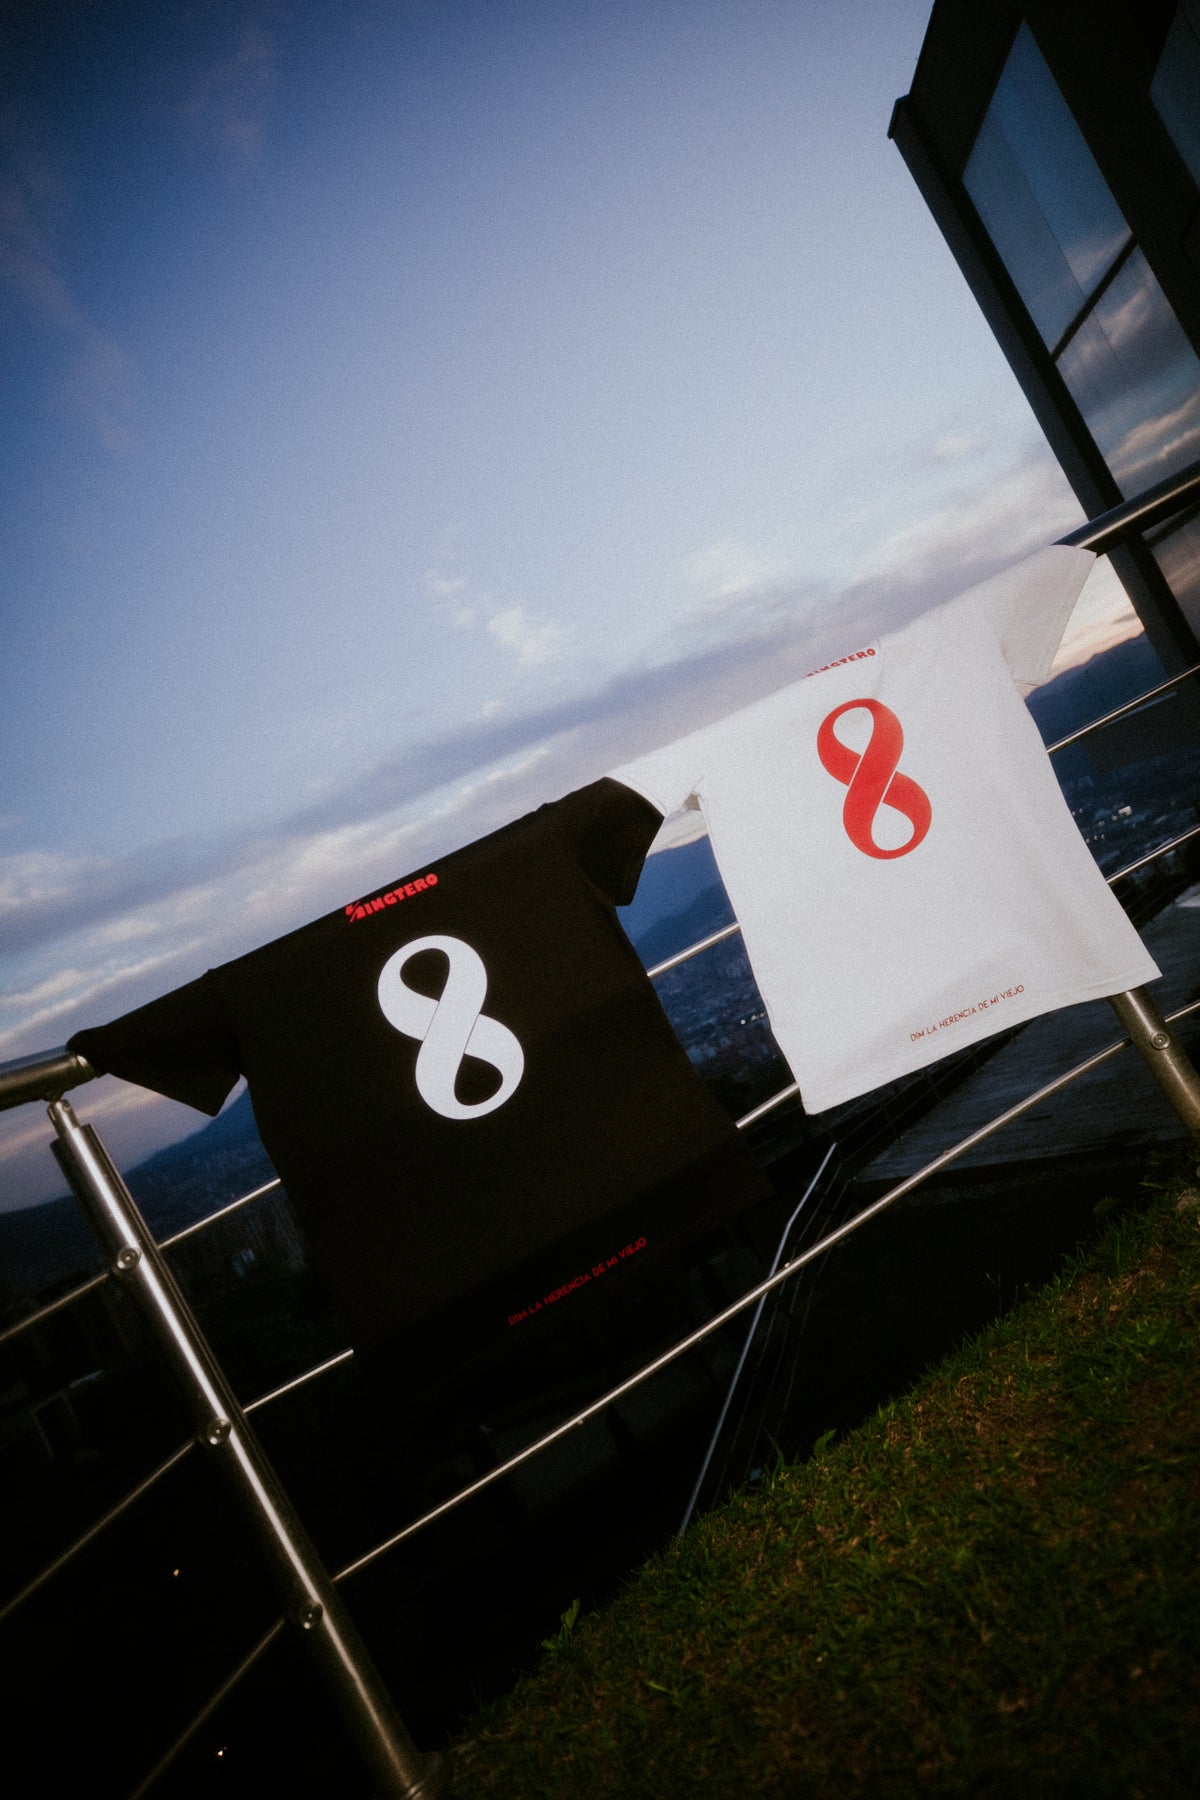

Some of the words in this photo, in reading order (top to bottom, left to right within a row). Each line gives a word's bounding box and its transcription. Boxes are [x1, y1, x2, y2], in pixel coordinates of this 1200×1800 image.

[817, 698, 932, 860] 8
[378, 935, 524, 1120] 8
[910, 1031, 925, 1042] DIM
[926, 1025, 937, 1035] LA
[939, 1007, 977, 1029] HERENCIA
[977, 1001, 988, 1011] DE
[990, 996, 1000, 1005] MI
[1000, 984, 1024, 1000] VIEJO
[508, 1309, 528, 1326] DIM
[528, 1301, 543, 1315] LA
[543, 1273, 592, 1307] HERENCIA
[591, 1263, 606, 1277] DE
[606, 1255, 618, 1268] MI
[618, 1237, 647, 1258] VIEJO
